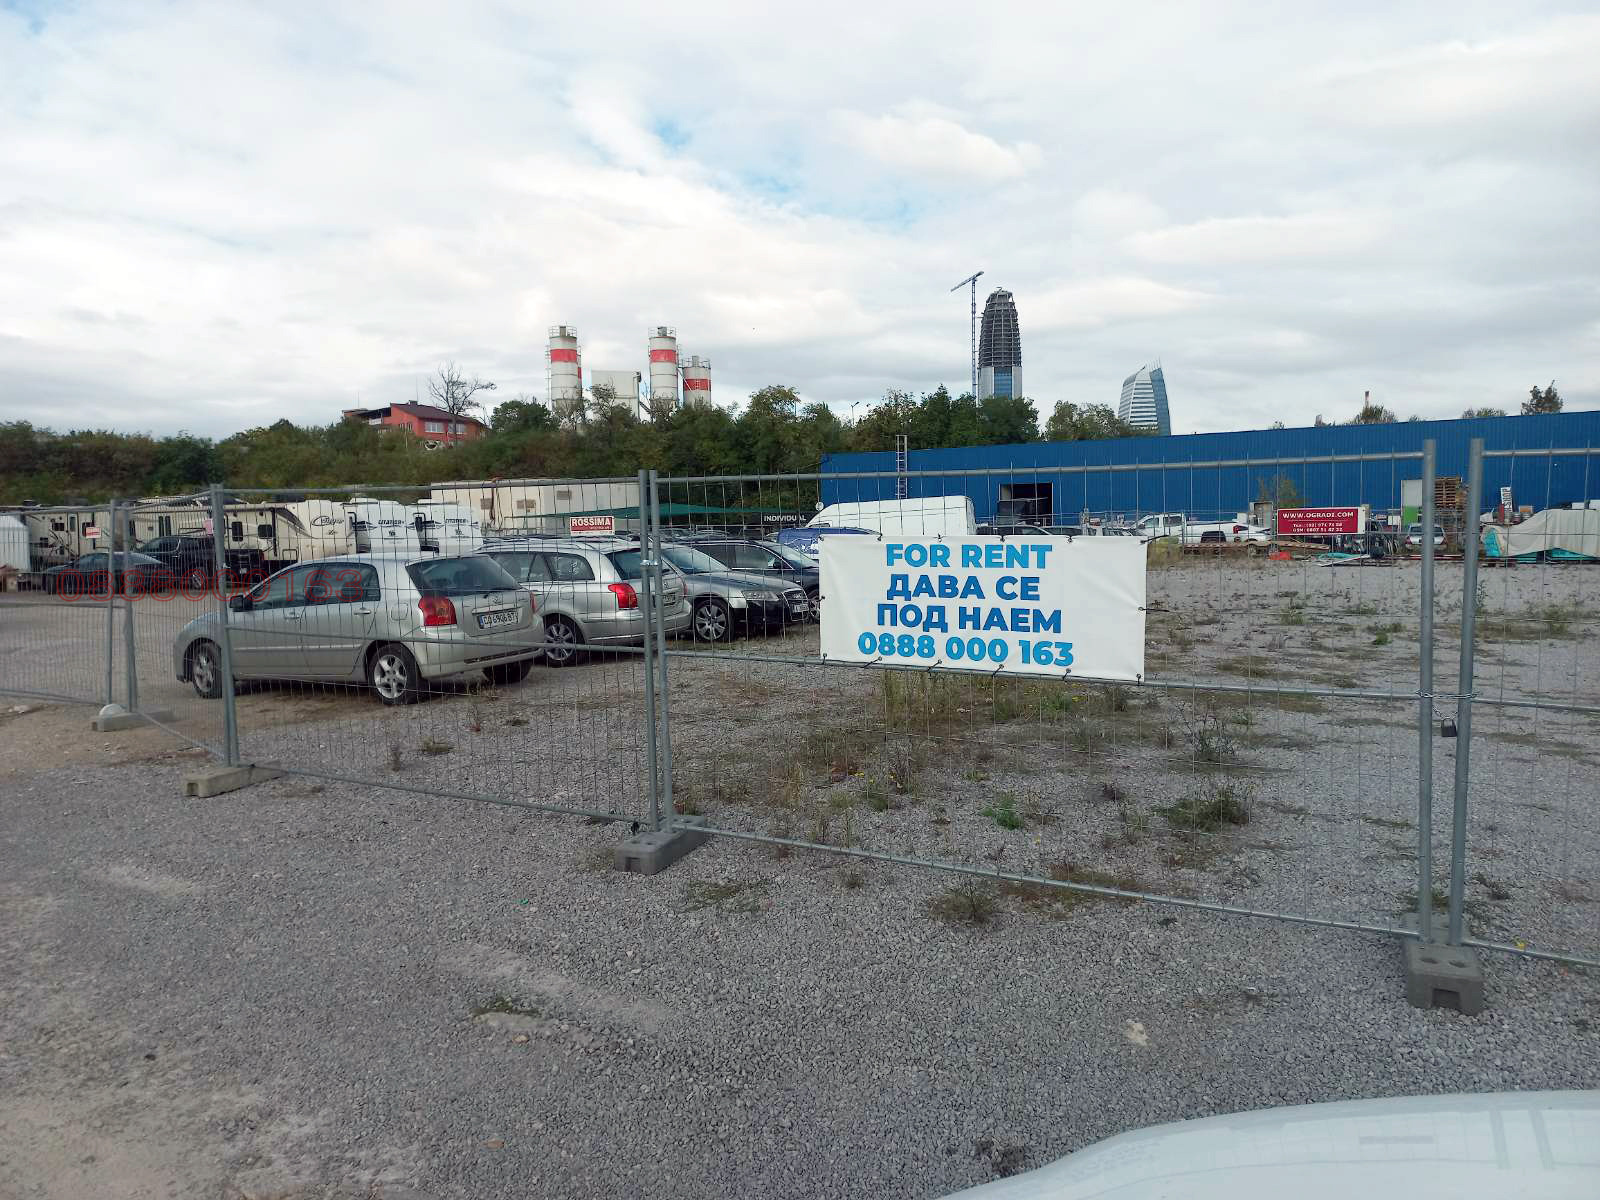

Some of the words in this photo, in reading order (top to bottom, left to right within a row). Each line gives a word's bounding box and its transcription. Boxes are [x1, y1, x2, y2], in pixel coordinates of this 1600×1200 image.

[572, 517, 612, 526] ROSSIMA
[886, 543, 951, 567] FOR
[961, 544, 1053, 569] RENT
[886, 573, 986, 601] ДАВА
[995, 576, 1040, 601] СЕ
[877, 603, 948, 633] ПОД
[959, 606, 1062, 633] НАЕМ
[857, 631, 936, 658] 0888
[945, 636, 1009, 663] 000
[1018, 639, 1074, 667] 163
